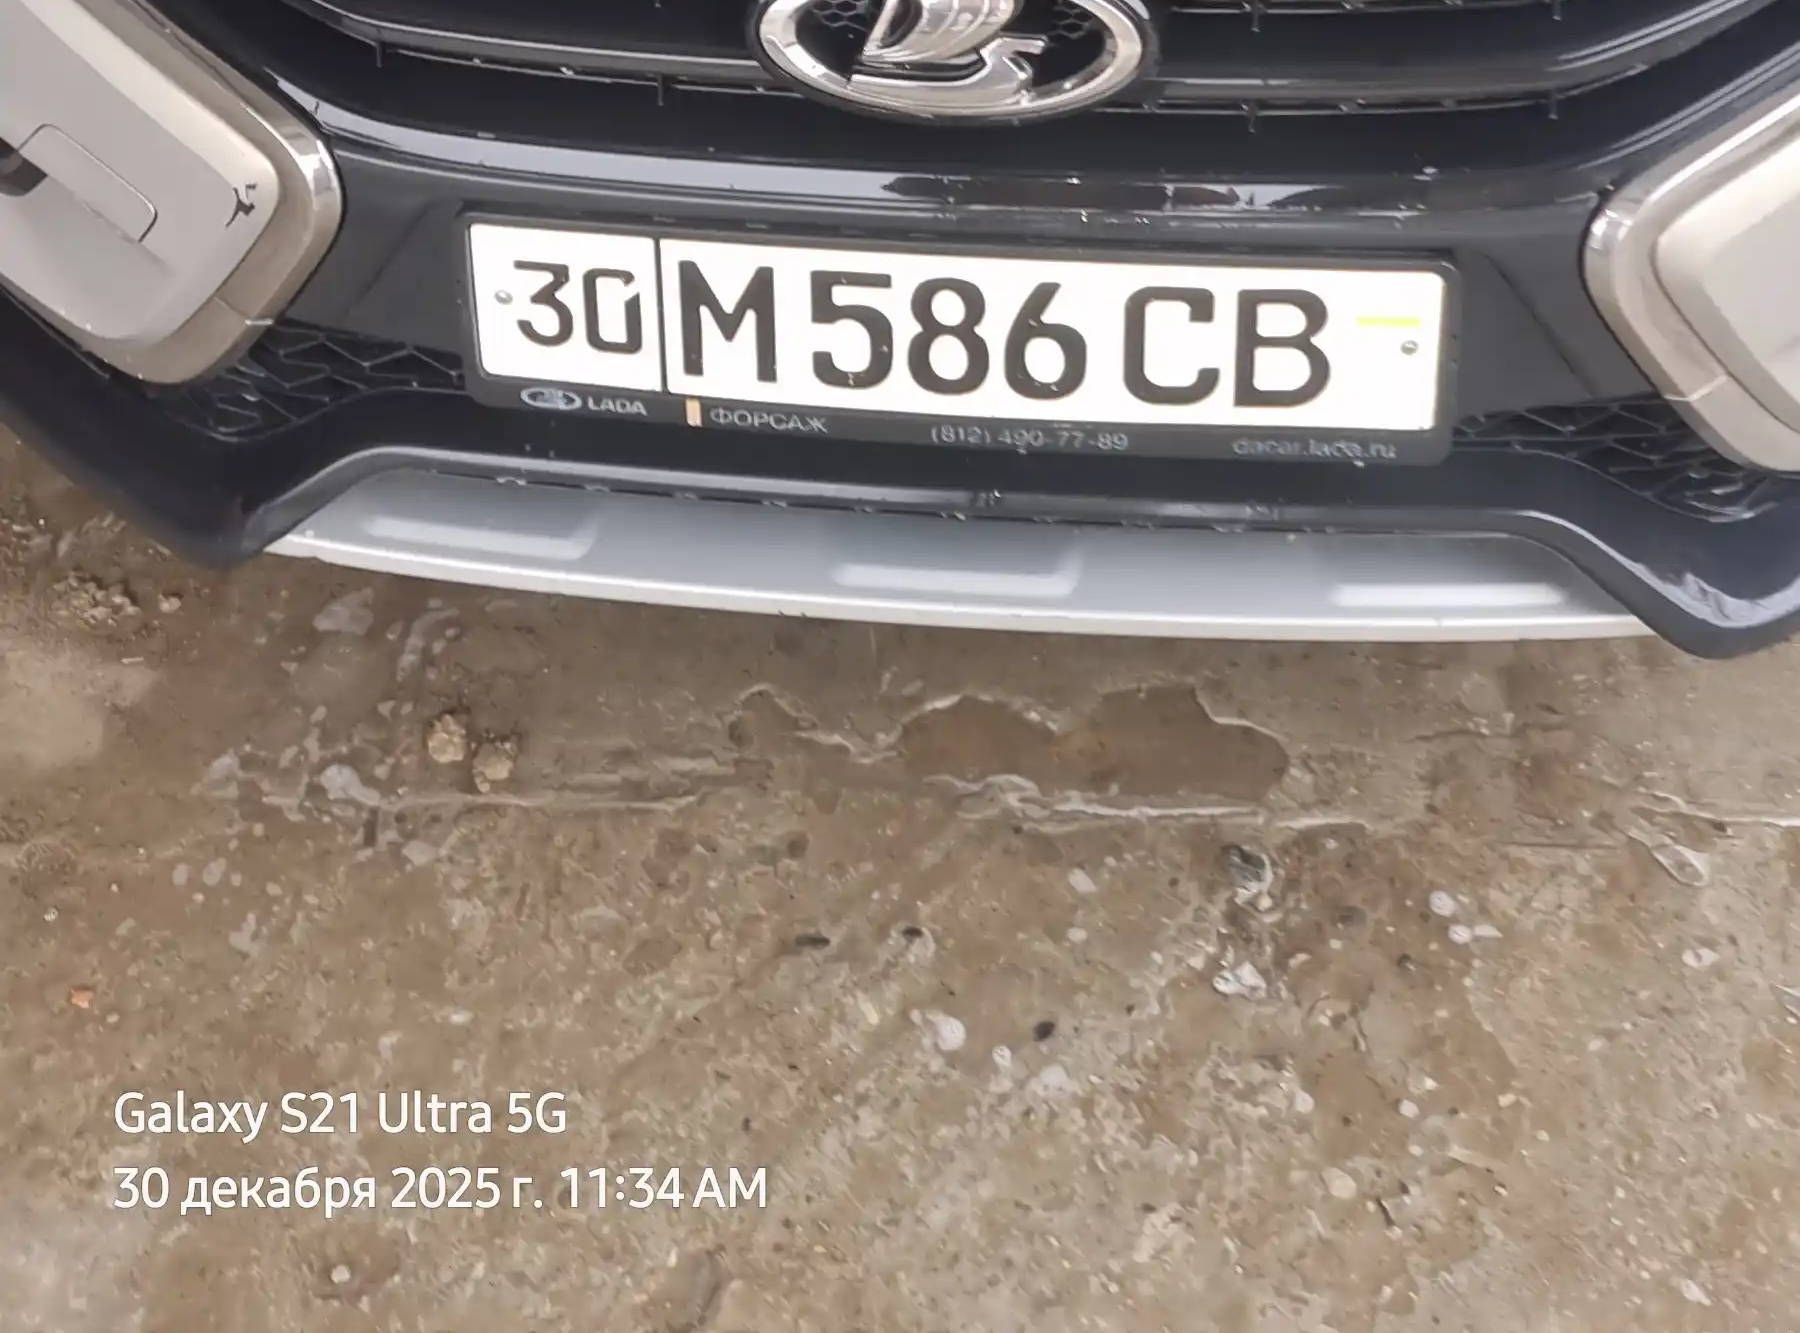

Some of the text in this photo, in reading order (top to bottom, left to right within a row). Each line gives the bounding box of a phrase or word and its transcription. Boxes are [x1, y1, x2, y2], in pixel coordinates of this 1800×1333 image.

[514, 259, 642, 354] 30
[810, 269, 1087, 399] 586
[1122, 285, 1331, 407] CB
[587, 396, 648, 416] LADA
[710, 407, 828, 434] ФОРСАЖ
[931, 424, 991, 445] (812)
